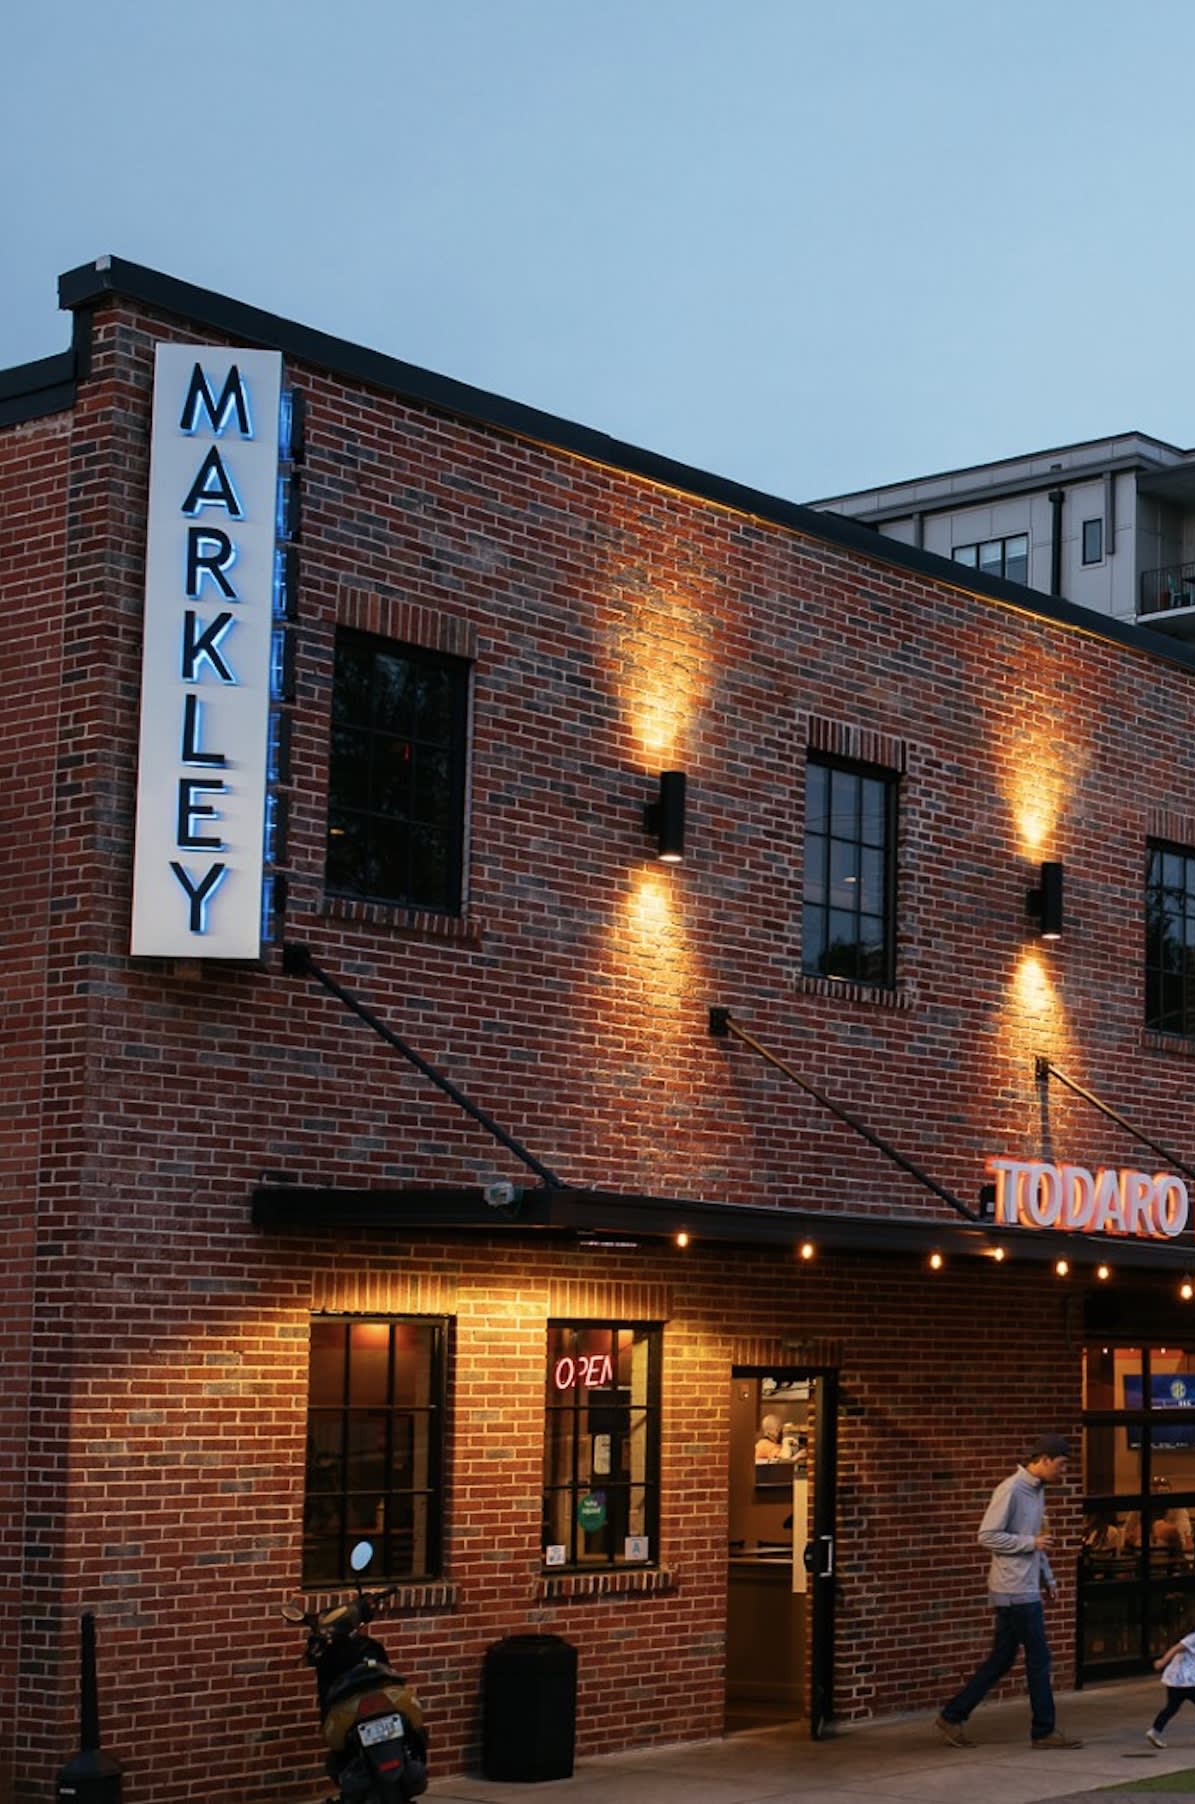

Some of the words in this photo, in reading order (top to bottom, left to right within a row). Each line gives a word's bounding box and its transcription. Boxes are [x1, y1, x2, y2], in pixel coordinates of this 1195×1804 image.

[170, 362, 252, 934] MARKLEY
[987, 1157, 1189, 1239] TODARO
[556, 1355, 613, 1390] OPEN
